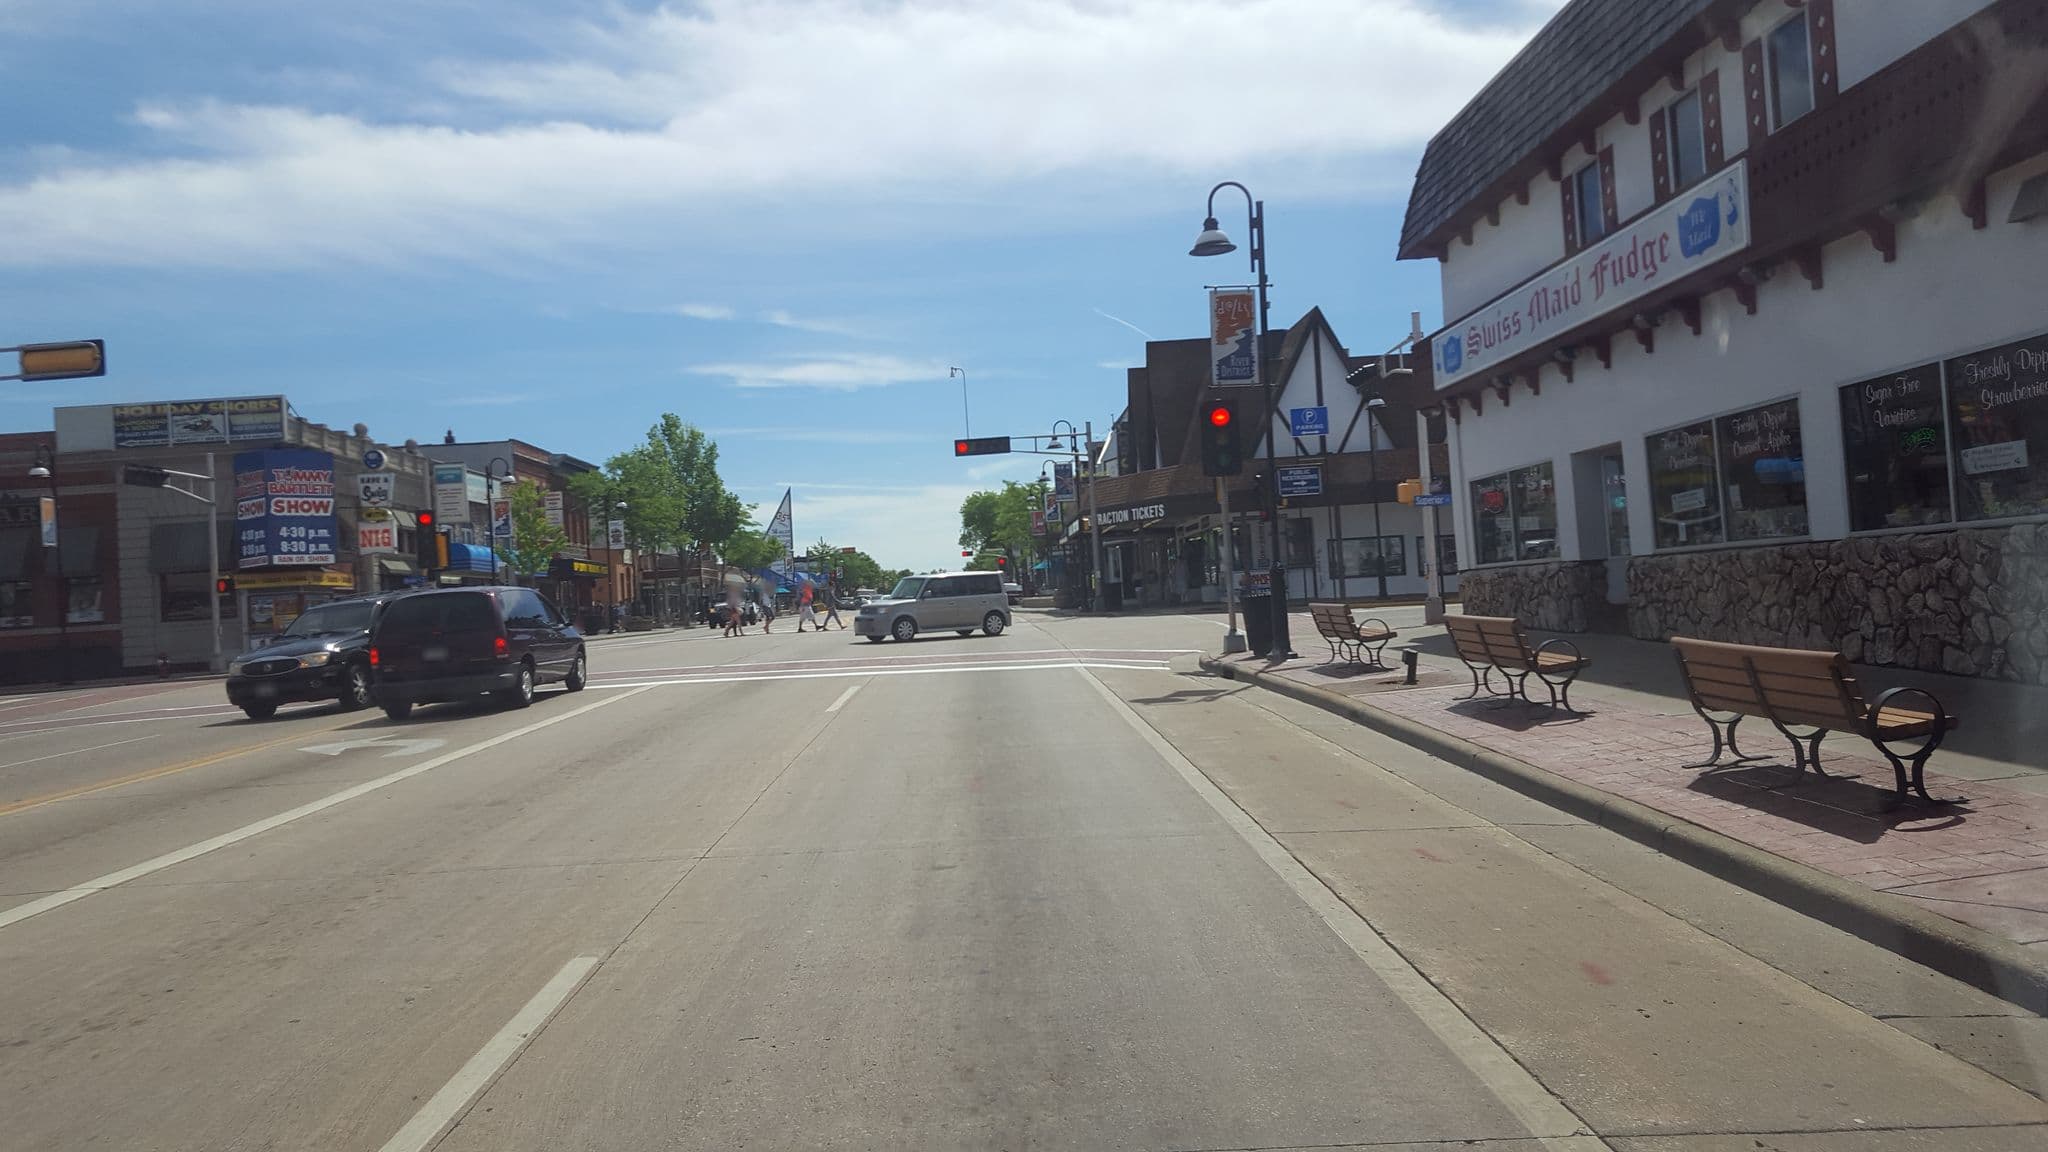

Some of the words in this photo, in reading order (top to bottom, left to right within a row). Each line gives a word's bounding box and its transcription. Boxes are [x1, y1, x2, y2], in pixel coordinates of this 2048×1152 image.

[1466, 310, 1522, 360] Swiss
[1527, 265, 1582, 333] Maid
[1589, 231, 1671, 302] Fudge
[1964, 355, 2011, 384] Freshly
[1865, 383, 1893, 406] Sugar
[1895, 376, 1921, 398] Free
[114, 401, 202, 418] HOLIDAY
[206, 398, 281, 414] SHORES
[1872, 408, 1917, 428] Varieties
[1295, 423, 1325, 431] PARKING
[272, 468, 332, 484] TOMMY
[268, 482, 334, 496] BARTLETT
[273, 499, 332, 514] SHOW
[1415, 495, 1444, 506] Superior
[1096, 509, 1129, 526] RACTION
[1132, 504, 1165, 521] TICKETS
[279, 526, 306, 538] 4:30
[308, 528, 331, 540] p.m.
[280, 541, 306, 552] 8:30
[308, 543, 332, 554] p.m.
